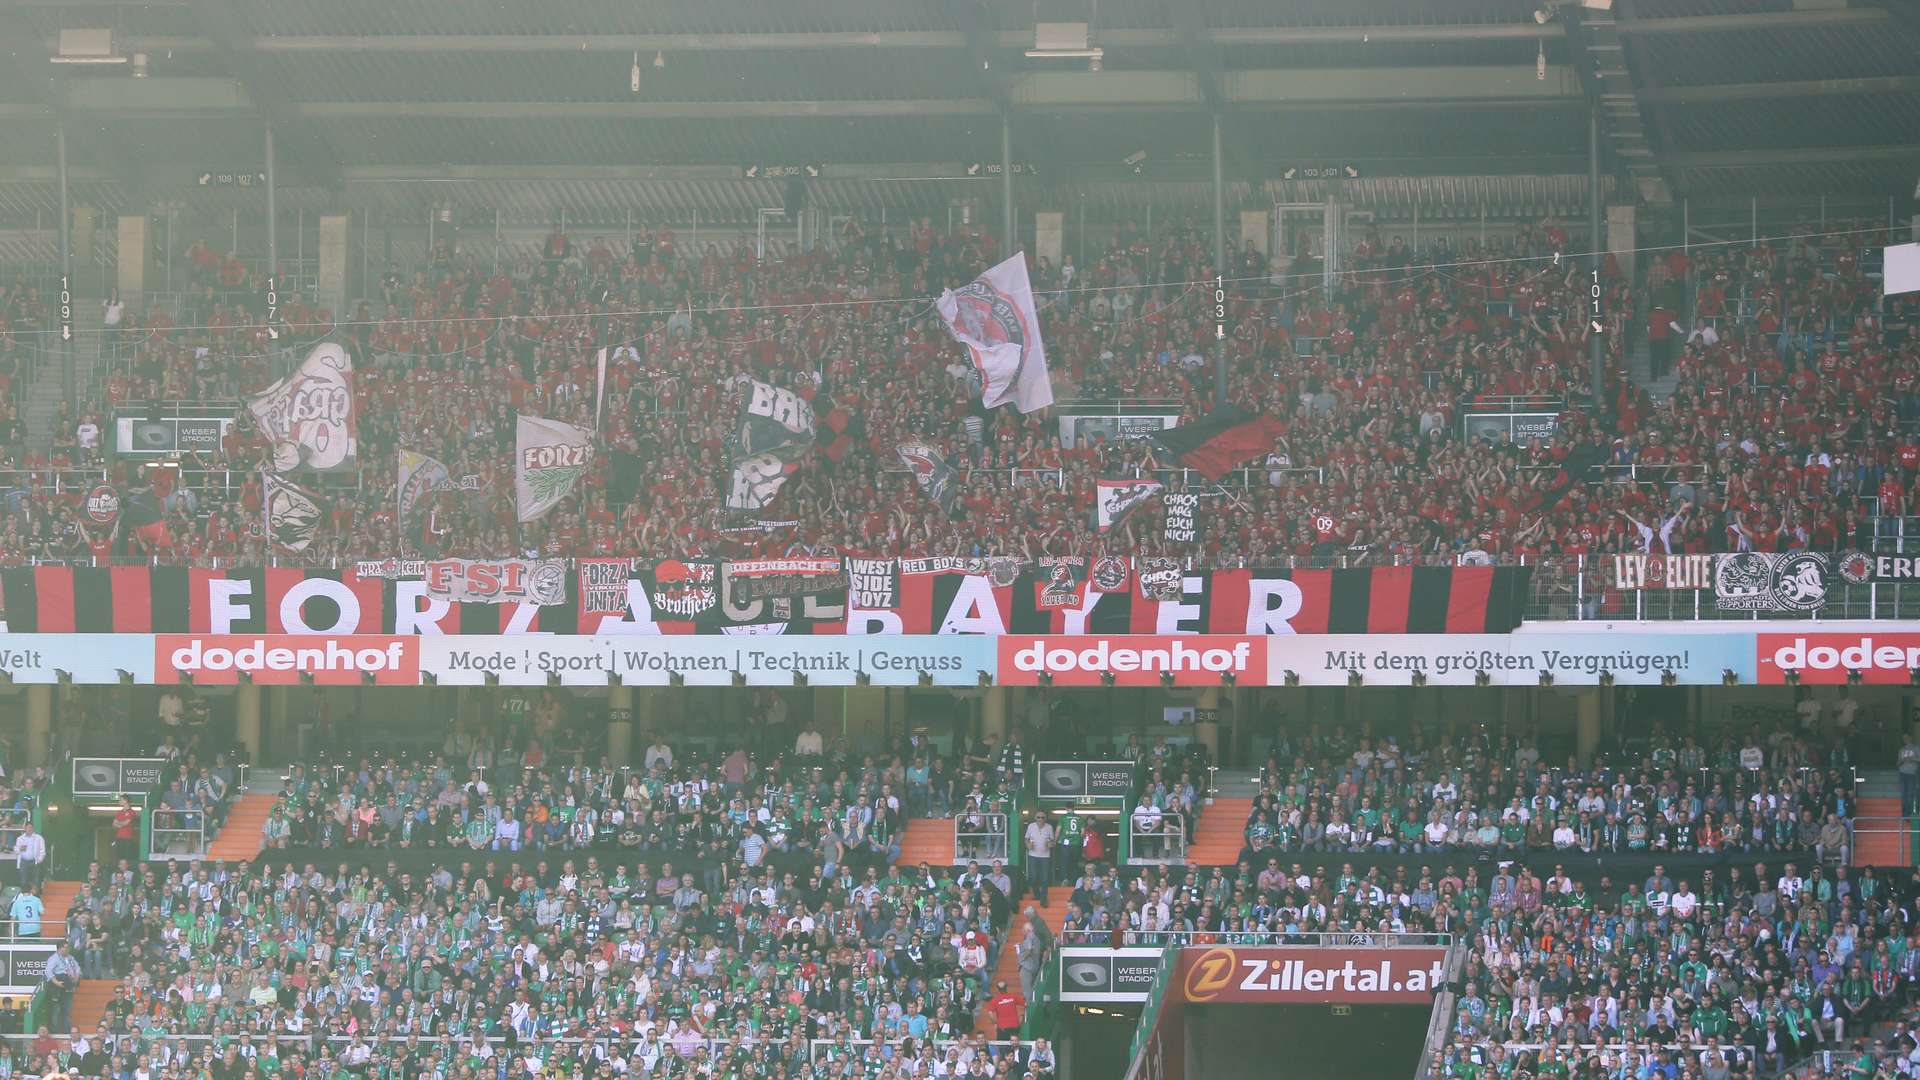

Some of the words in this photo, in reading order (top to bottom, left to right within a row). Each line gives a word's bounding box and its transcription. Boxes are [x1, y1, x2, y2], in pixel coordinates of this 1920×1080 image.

[61, 276, 70, 319] 109
[267, 277, 277, 319] 107
[1215, 275, 1225, 318] 103
[1591, 269, 1600, 313] 101
[182, 428, 217, 436] WESER
[1163, 494, 1198, 507] CHAOS
[1168, 505, 1192, 517] MAG
[1164, 529, 1196, 541] NICHT
[1166, 518, 1193, 530] EUCH
[1317, 518, 1333, 531] 09
[582, 562, 630, 585] FORZA
[853, 559, 894, 575] WEST
[903, 561, 927, 573] RED
[933, 556, 964, 570] BOYS
[1616, 555, 1647, 589] LEV
[1666, 555, 1712, 589] ELITE
[427, 561, 527, 596] FSI
[853, 574, 893, 591] SIDE
[584, 590, 630, 613] UNITA
[653, 592, 717, 620] Brothers
[171, 640, 403, 671] dodenhof
[449, 651, 517, 670] Mode
[538, 651, 603, 675] Sport
[624, 651, 728, 670] Wohnen
[749, 650, 850, 670] Technik
[871, 651, 963, 670] Genuss
[1014, 641, 1250, 671] dodenhof
[1325, 651, 1366, 670] Mit
[1373, 651, 1428, 670] dem
[1435, 651, 1535, 675] größten
[1541, 650, 1689, 675] Vergnügen!
[1070, 818, 1078, 831] 6
[25, 905, 33, 918] 3
[1117, 967, 1156, 975] WESER
[1240, 959, 1444, 992] Zillertal.at
